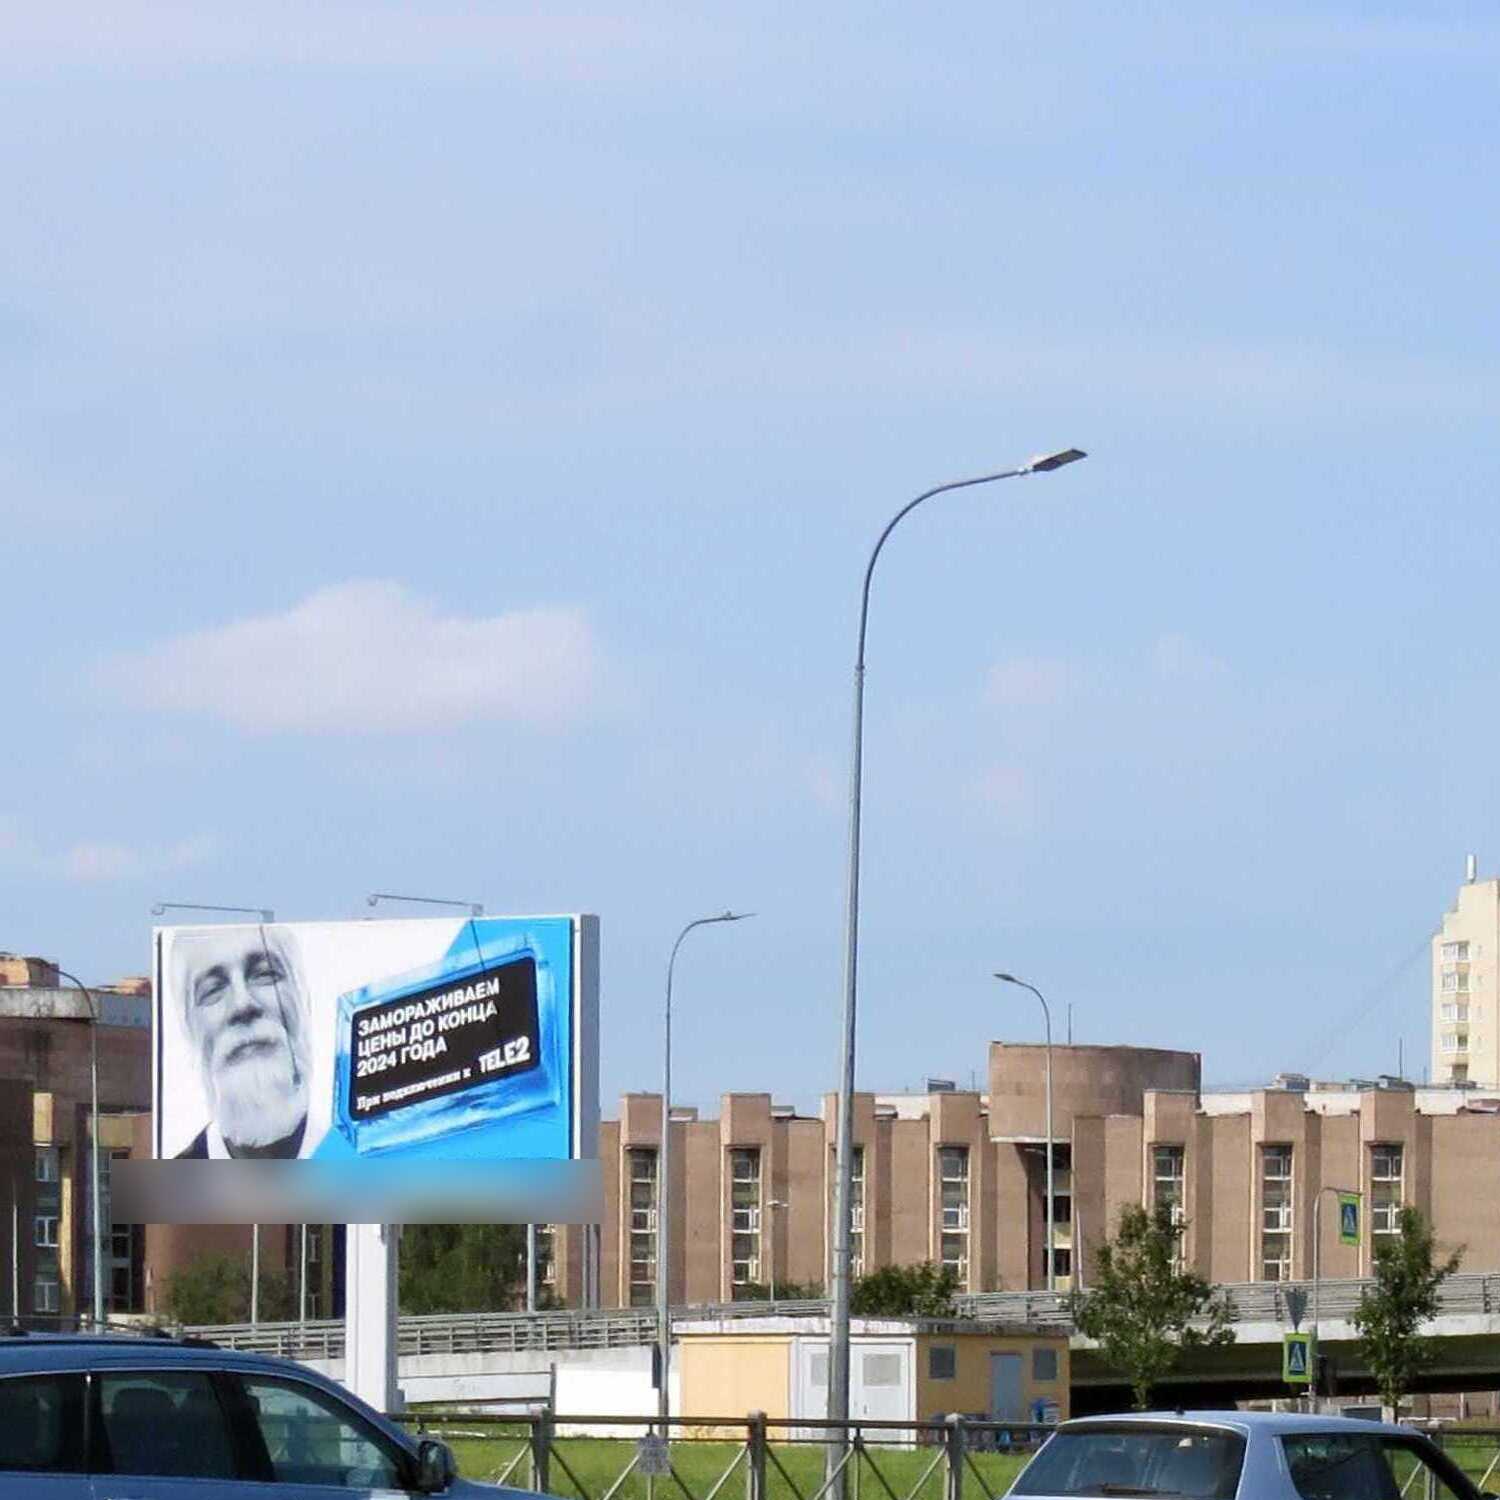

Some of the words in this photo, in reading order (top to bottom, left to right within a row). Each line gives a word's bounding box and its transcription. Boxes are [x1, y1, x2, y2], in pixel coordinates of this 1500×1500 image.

[358, 977, 500, 1036] ЗАМОРАЖИВАЕМ
[358, 1028, 406, 1058] ЦЕНЫ
[410, 1019, 435, 1044] ДО
[438, 1001, 498, 1032] КОНЦА
[357, 1052, 397, 1077] 2024
[401, 1037, 448, 1064] ГОДА
[479, 1035, 531, 1073] TELE2
